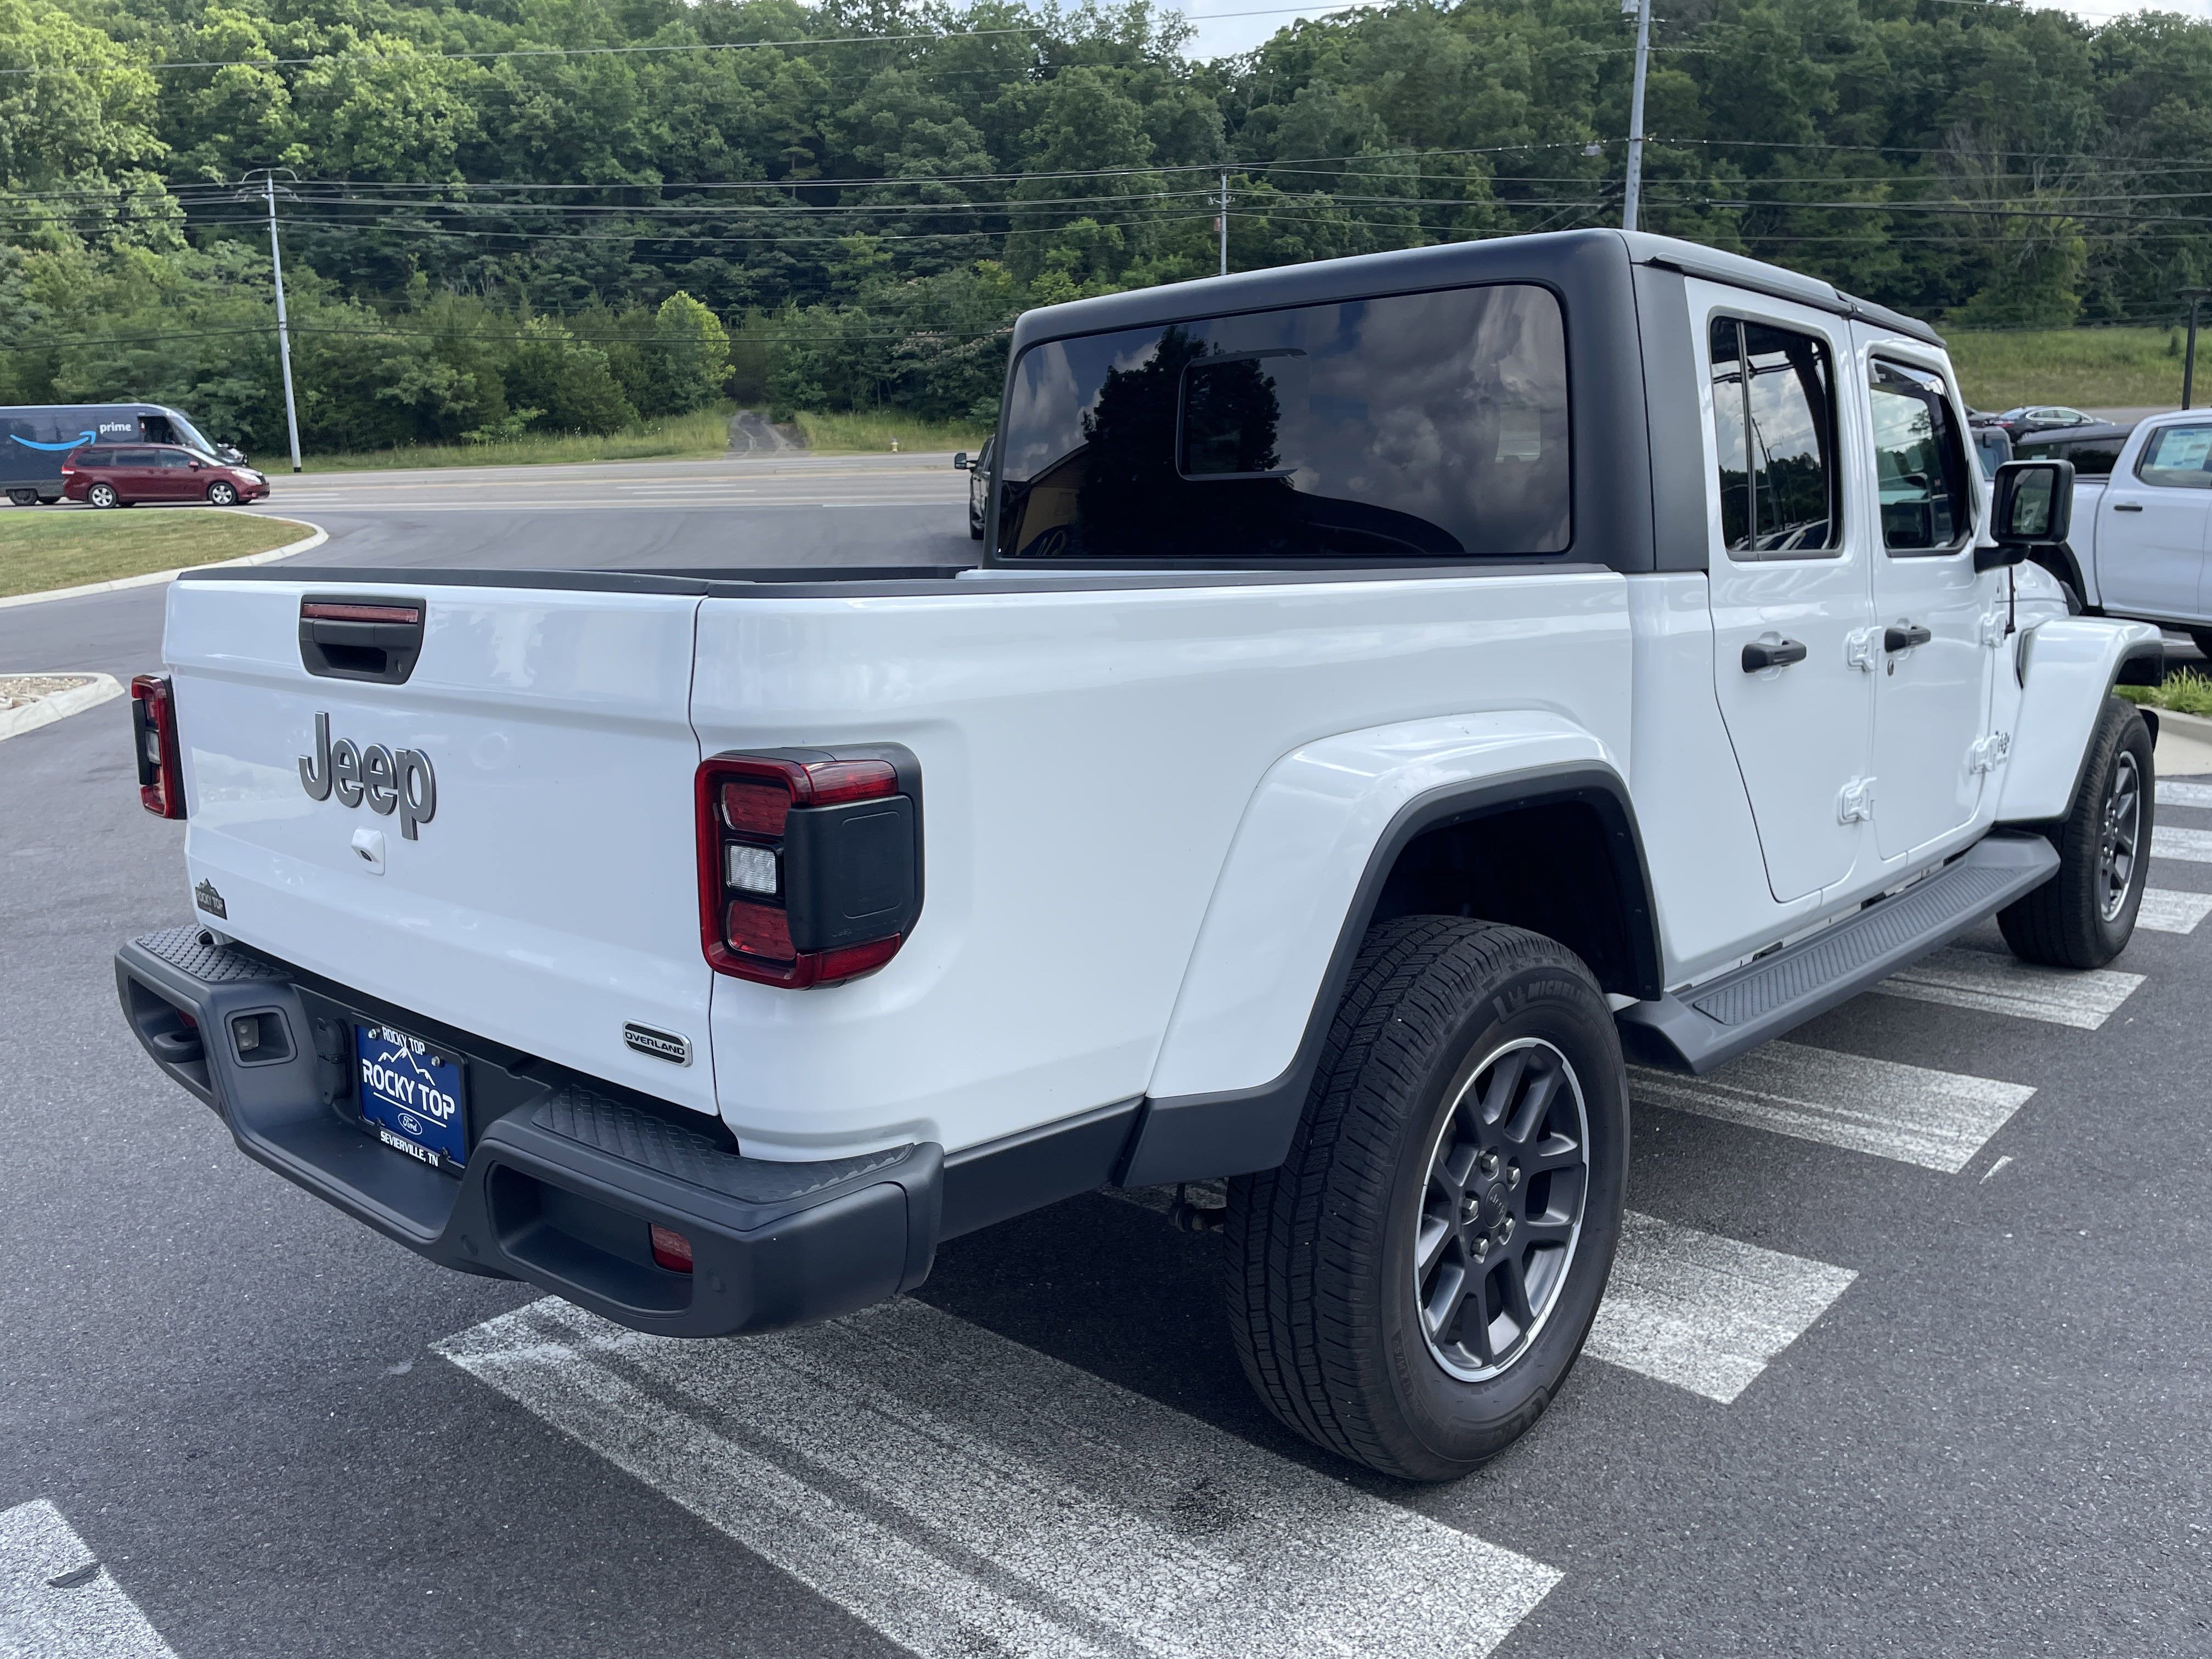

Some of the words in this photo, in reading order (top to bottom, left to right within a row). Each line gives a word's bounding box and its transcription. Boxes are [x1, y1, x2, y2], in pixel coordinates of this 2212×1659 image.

[99, 421, 132, 435] prime
[298, 711, 437, 840] Jeep
[382, 1026, 408, 1047] ROCKY
[409, 1037, 426, 1056] TOP
[625, 1031, 685, 1056] OVERLAND
[362, 1058, 415, 1105] ROCKY
[418, 1083, 455, 1120] TOP
[403, 1115, 417, 1132] Ford
[380, 1130, 426, 1163] SEVIERVILLE,
[428, 1152, 439, 1167] TN
